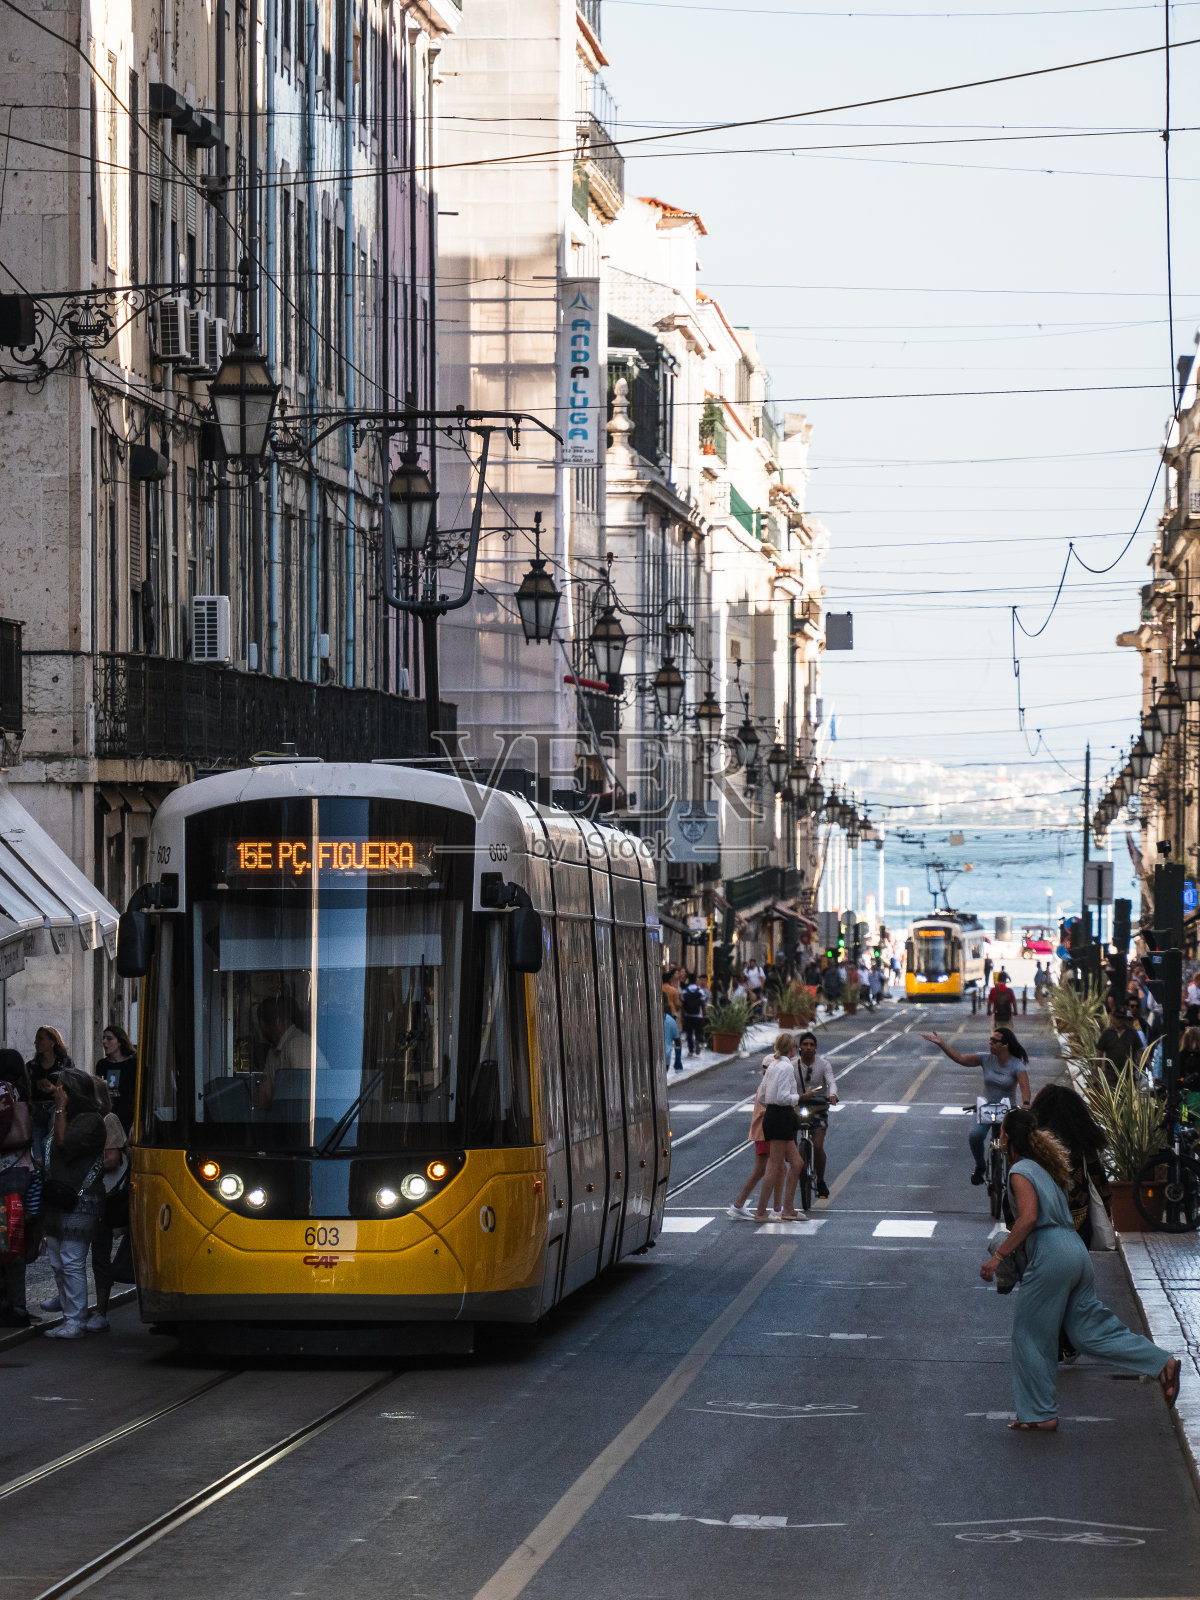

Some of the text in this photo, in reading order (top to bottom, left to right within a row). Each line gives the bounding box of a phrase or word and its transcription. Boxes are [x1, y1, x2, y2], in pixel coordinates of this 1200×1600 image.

[568, 318, 591, 441] ANDALUGA
[157, 845, 171, 864] 603
[236, 842, 414, 875] 15E PÇ. FIGUEIRA
[489, 843, 508, 862] 603
[305, 1226, 340, 1246] 603
[303, 1255, 340, 1269] CAF
